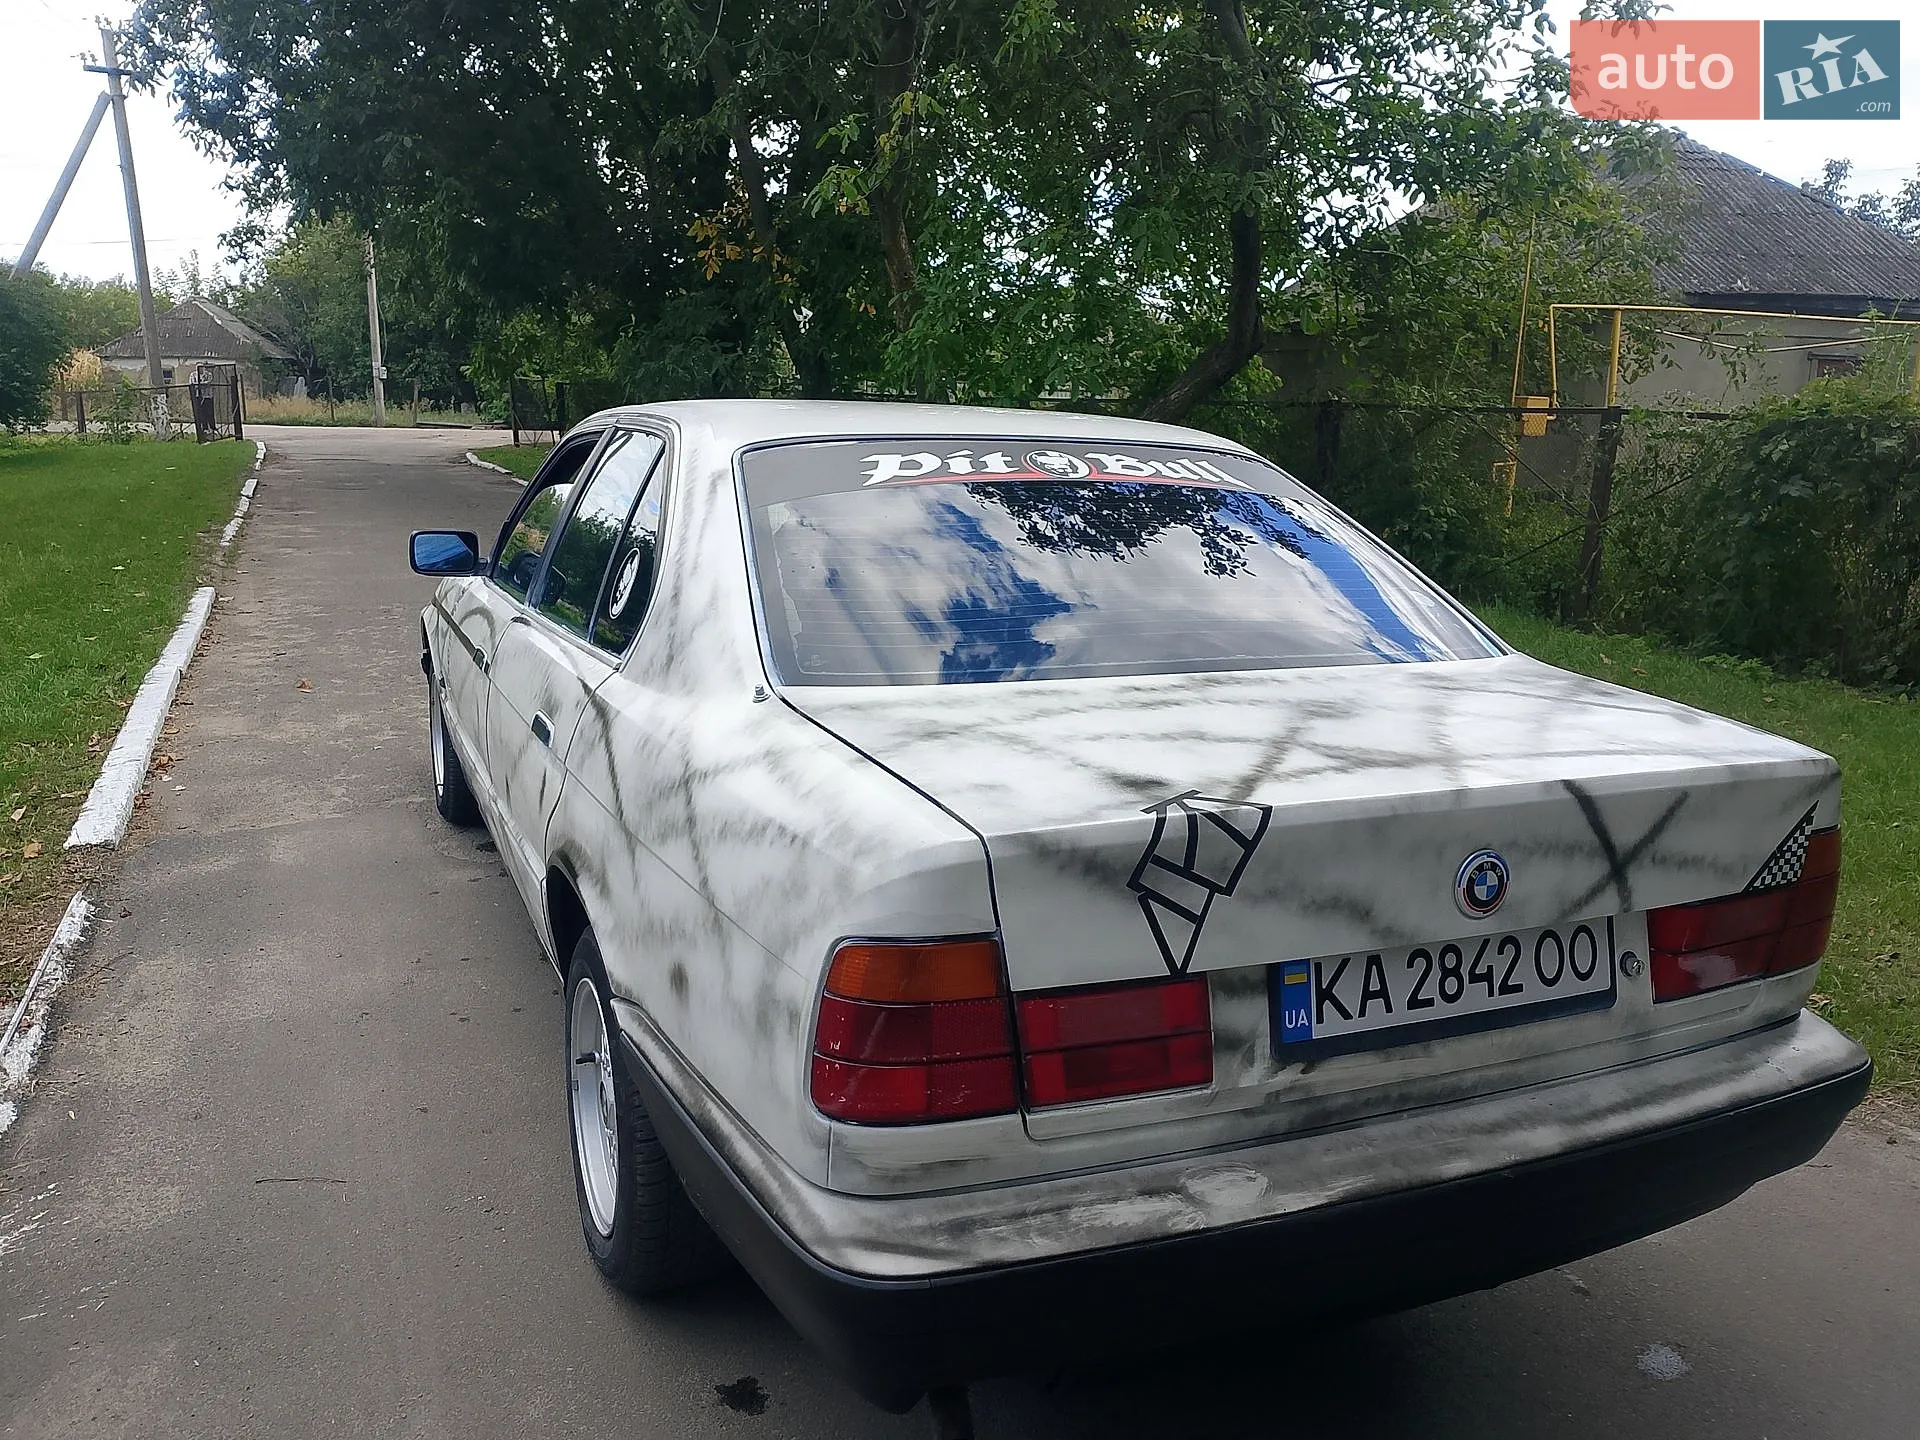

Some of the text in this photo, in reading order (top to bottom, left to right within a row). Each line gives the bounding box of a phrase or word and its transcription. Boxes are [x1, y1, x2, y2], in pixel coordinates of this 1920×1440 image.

[859, 450, 1257, 491] Pit Bull
[1313, 953, 1394, 1025] KA
[1406, 935, 1524, 1011] 2842
[1284, 1007, 1309, 1029] UA
